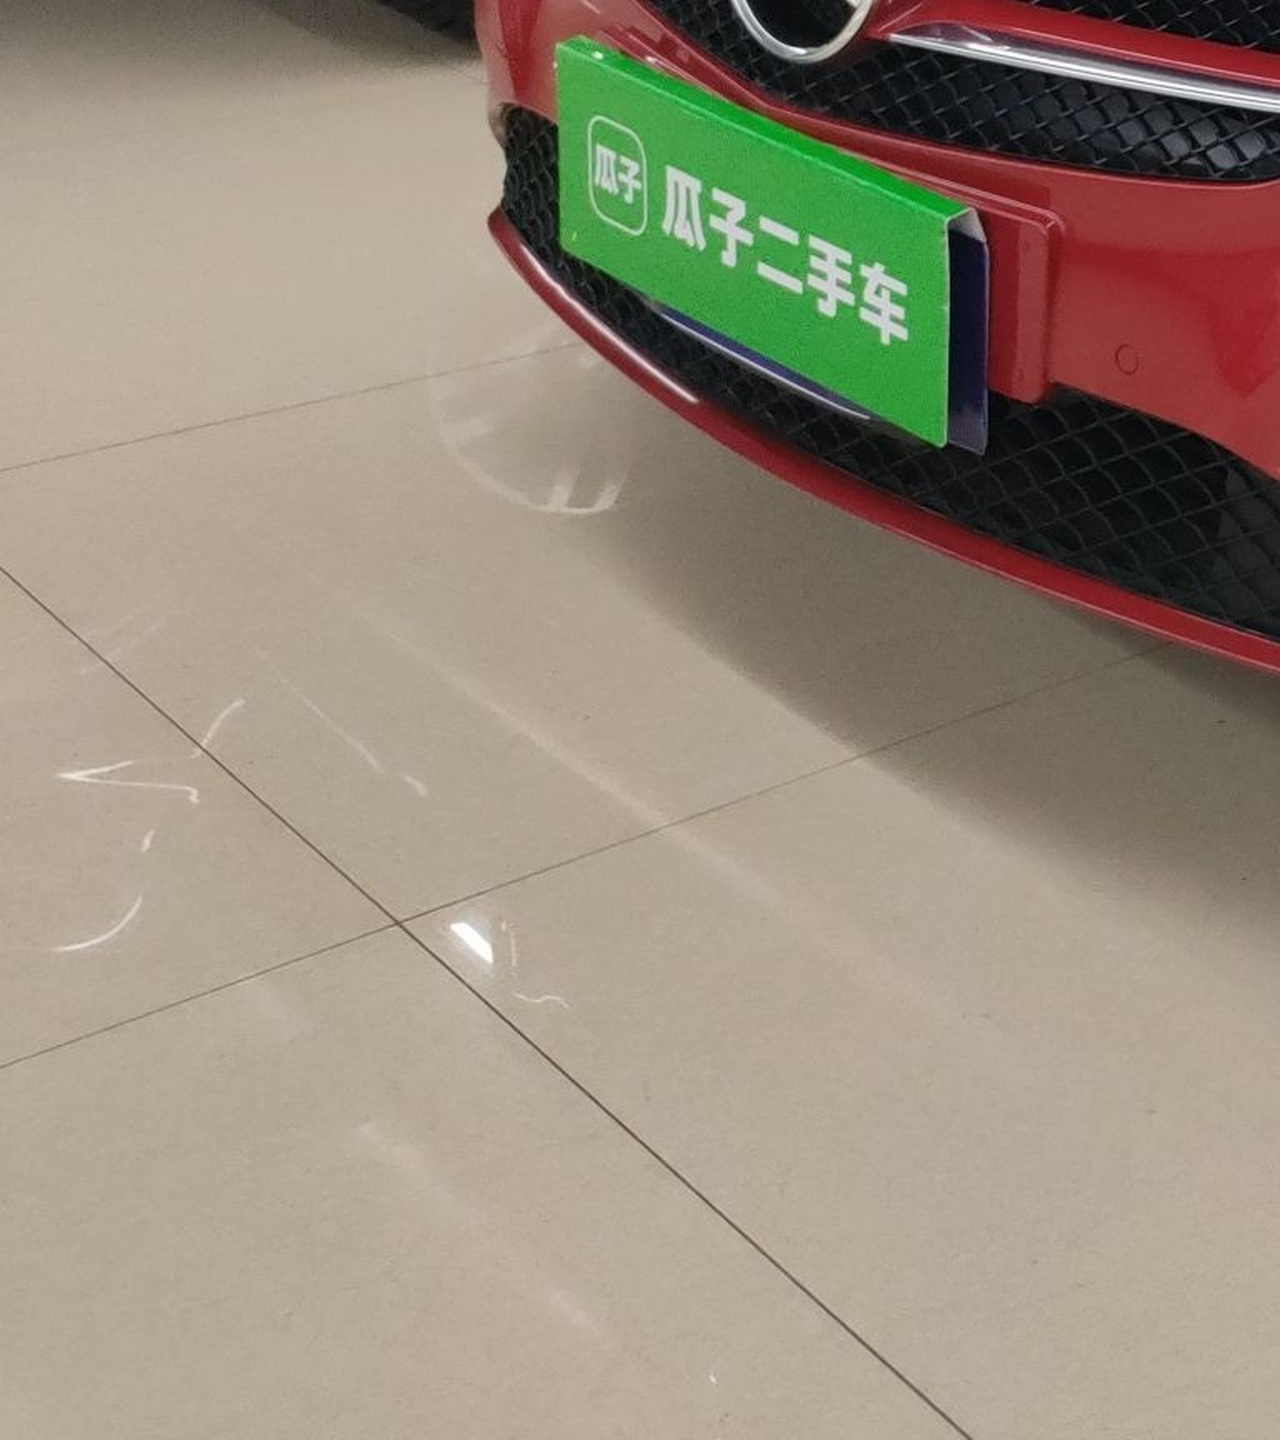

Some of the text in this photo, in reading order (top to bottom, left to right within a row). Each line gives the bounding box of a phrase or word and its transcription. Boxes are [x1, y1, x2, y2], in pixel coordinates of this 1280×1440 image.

[594, 143, 642, 204] 瓜子
[661, 164, 909, 346] 瓜子二手车
